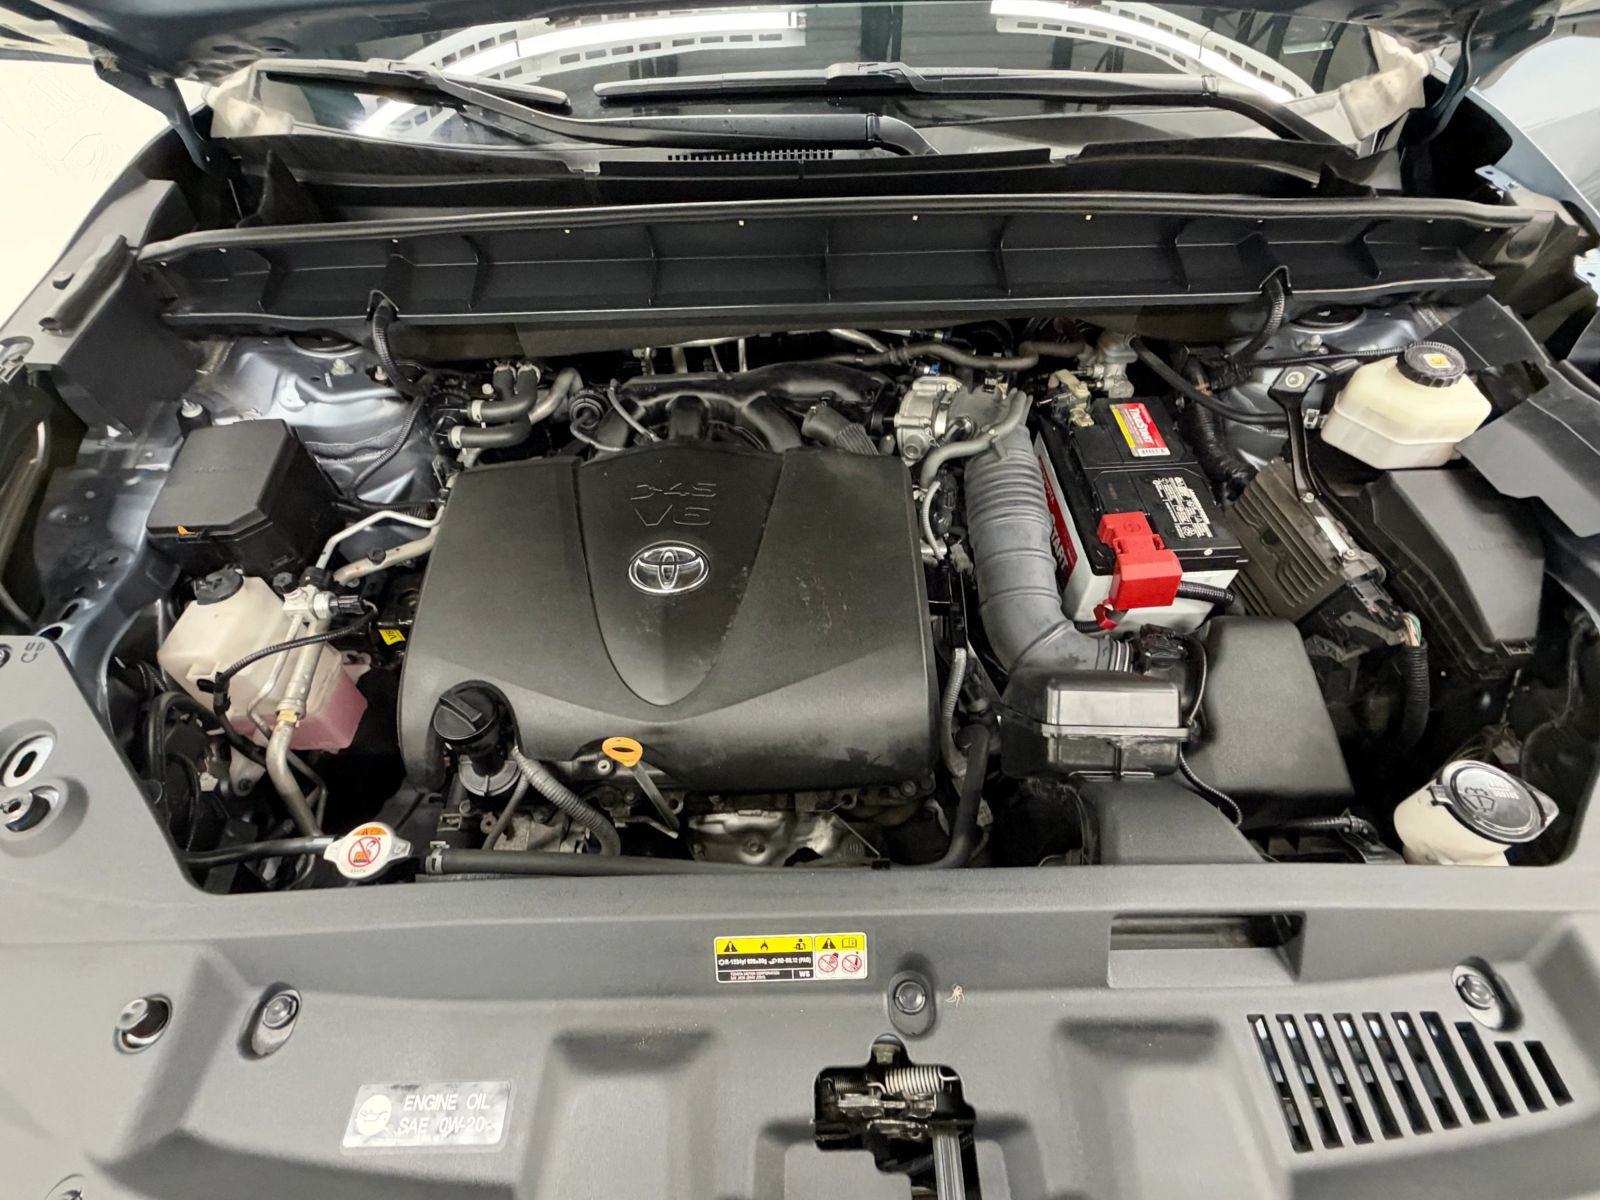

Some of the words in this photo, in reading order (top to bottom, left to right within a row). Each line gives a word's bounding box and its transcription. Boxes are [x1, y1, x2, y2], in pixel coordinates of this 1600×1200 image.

[634, 504, 711, 526] V6
[403, 1093, 459, 1112] ENGINE
[466, 1093, 491, 1110] OIL
[399, 1117, 430, 1134] SAE
[438, 1116, 486, 1136] 0W-20
